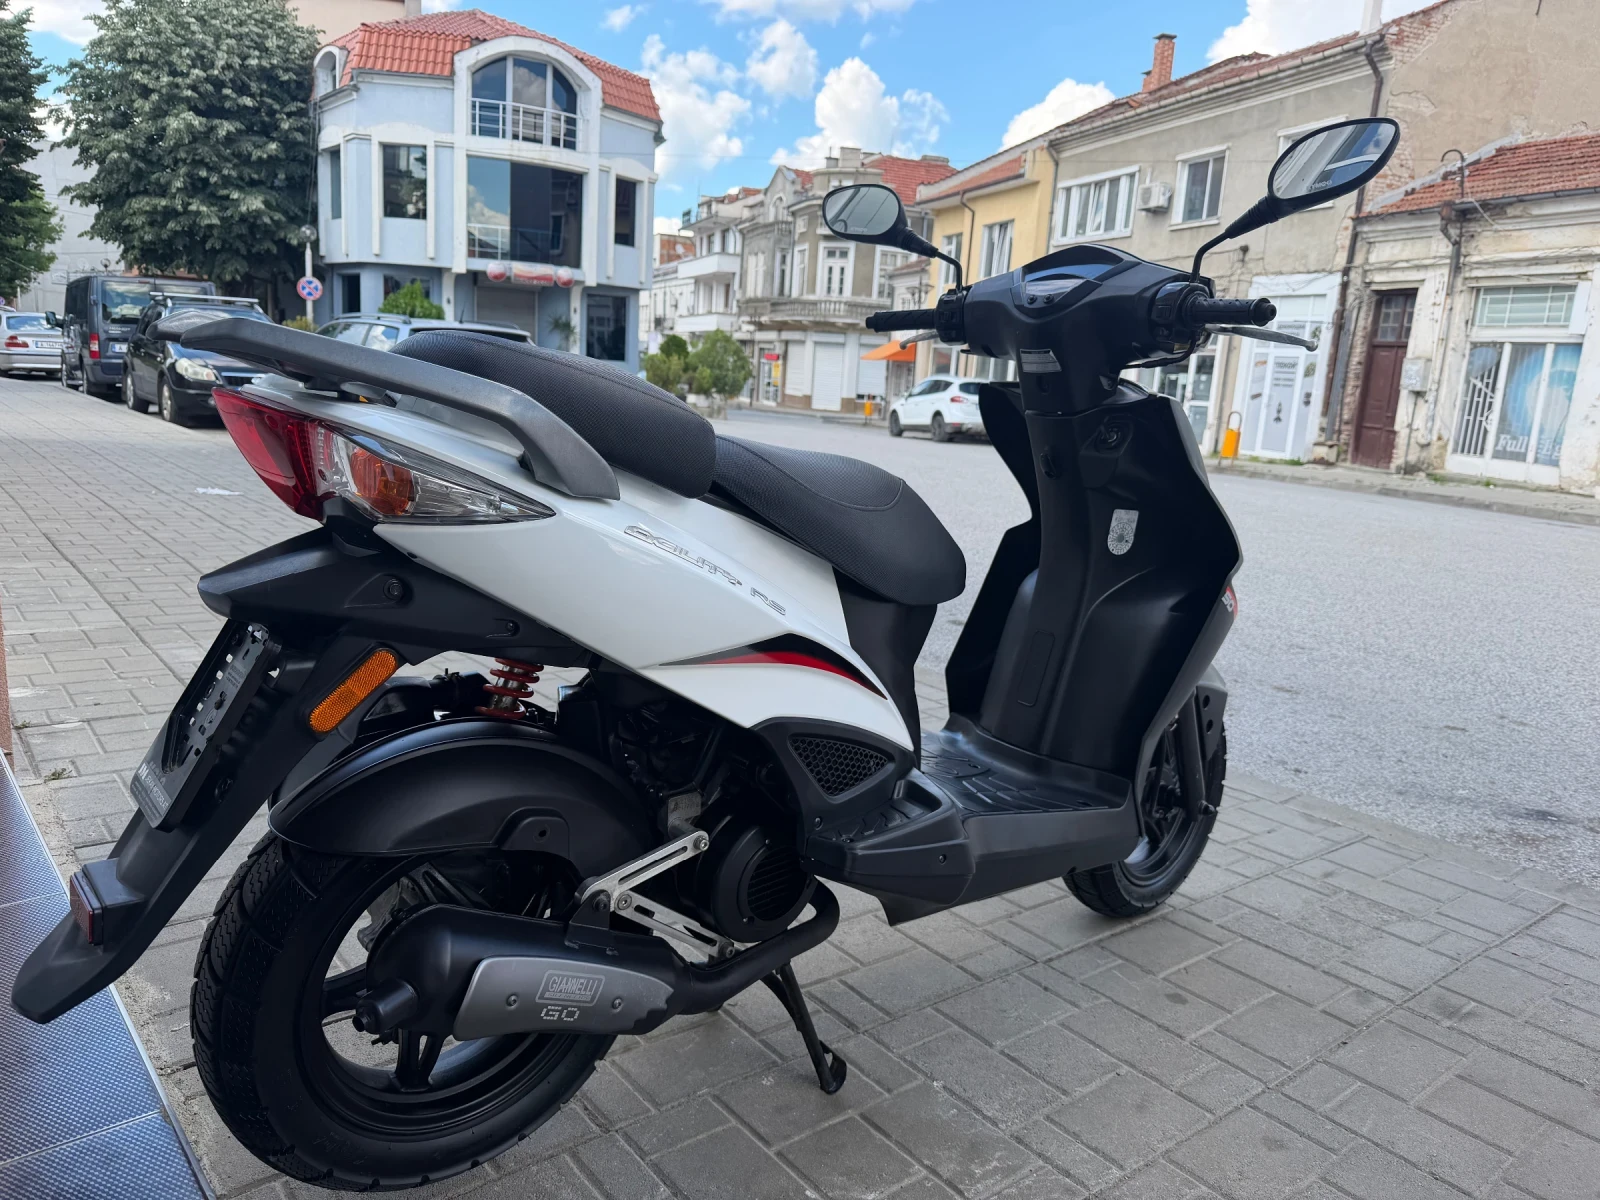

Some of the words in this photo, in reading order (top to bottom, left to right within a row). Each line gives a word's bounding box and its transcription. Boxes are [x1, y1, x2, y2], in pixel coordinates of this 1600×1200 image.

[1496, 433, 1529, 453] Full
[750, 587, 786, 616] RS
[548, 976, 598, 996] GIANNELLI
[540, 1005, 580, 1021] GO
